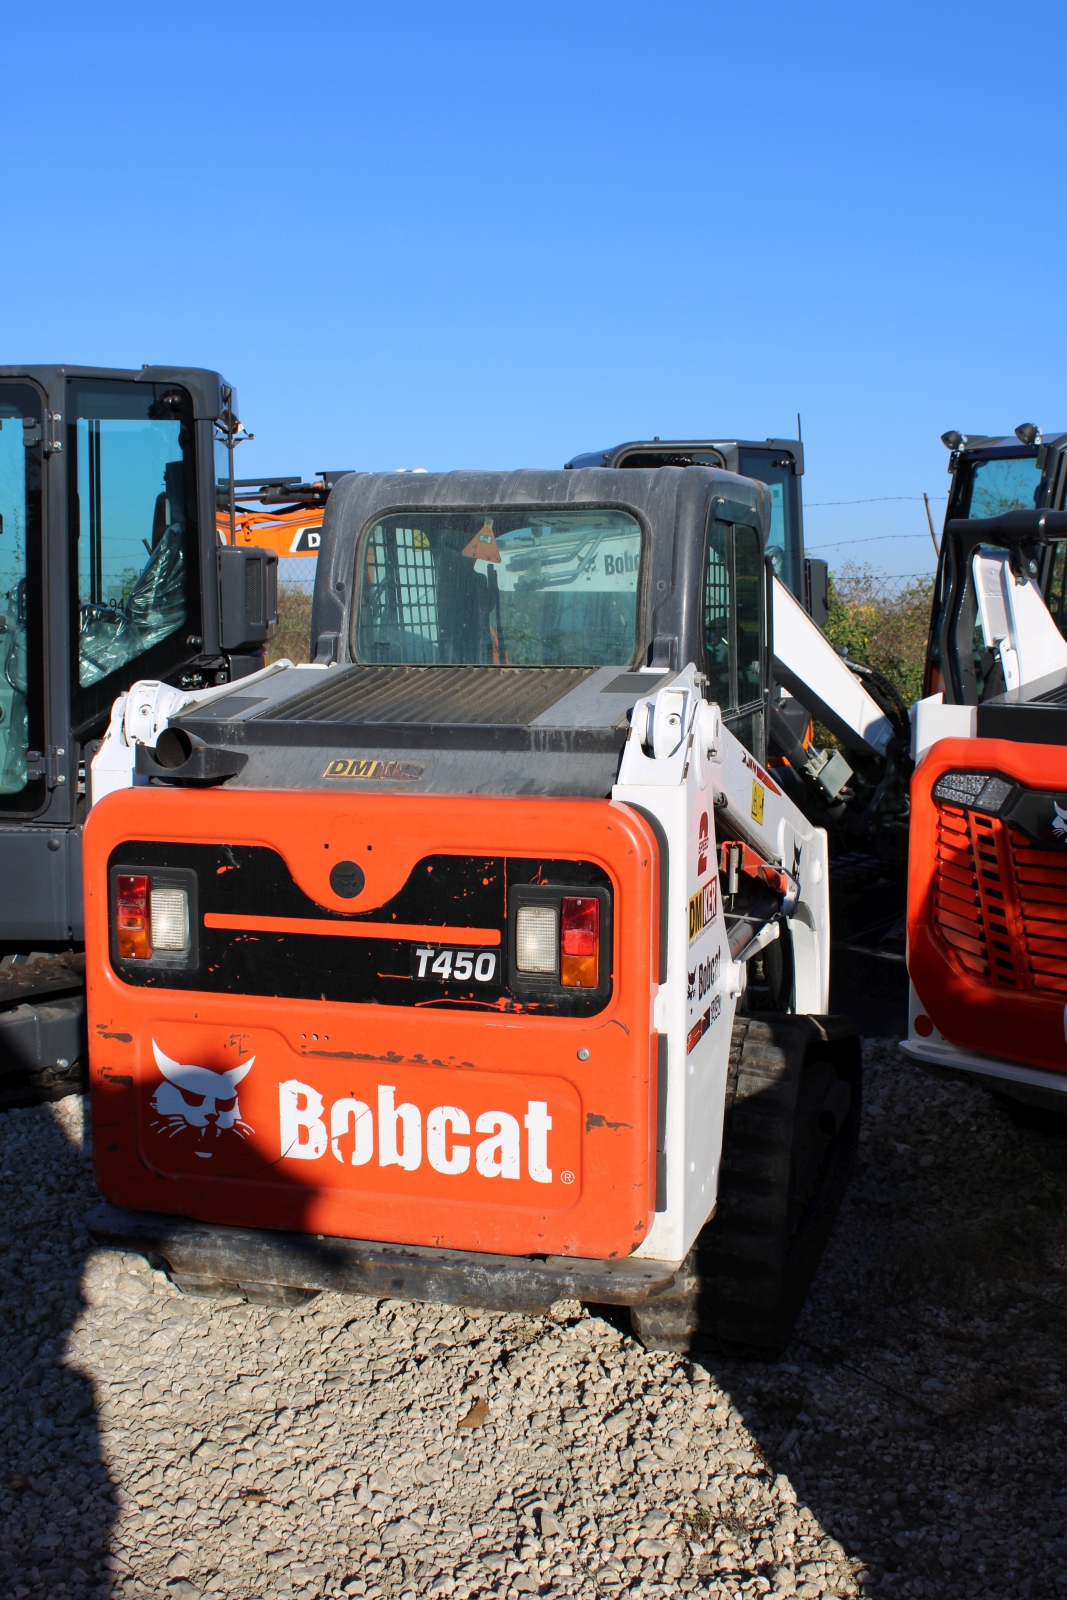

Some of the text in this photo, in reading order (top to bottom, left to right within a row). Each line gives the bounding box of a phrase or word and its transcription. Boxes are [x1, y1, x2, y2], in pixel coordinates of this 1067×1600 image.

[416, 948, 497, 982] T450
[698, 945, 721, 1001] Bobcat
[278, 1079, 553, 1184] Bobcat
